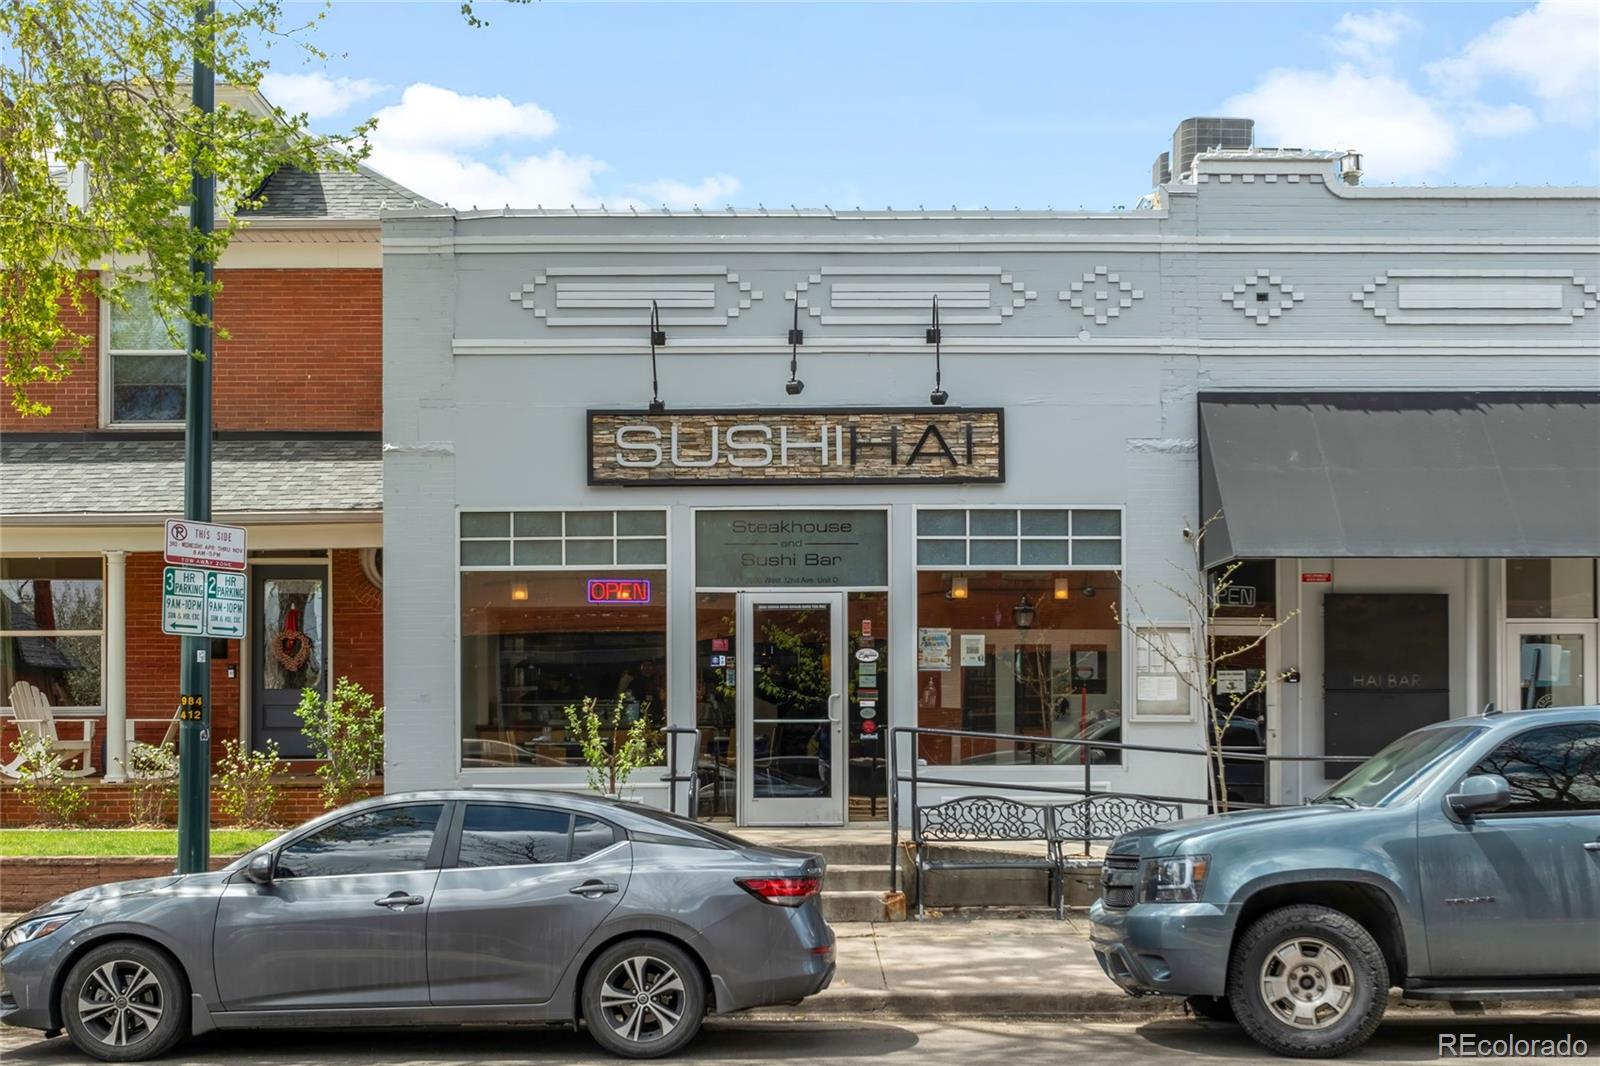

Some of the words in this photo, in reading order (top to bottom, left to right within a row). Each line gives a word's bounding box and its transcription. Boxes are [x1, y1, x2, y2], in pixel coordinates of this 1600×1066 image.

[732, 520, 852, 534] Steakhouse
[195, 529, 210, 540] THIS
[217, 532, 232, 542] SIDE
[780, 540, 803, 548] and
[740, 553, 796, 567] Sushi
[804, 553, 842, 567] Bar
[166, 572, 174, 591] 3
[183, 572, 196, 583] HR
[225, 576, 237, 587] HR
[174, 582, 203, 595] PARKING
[208, 576, 216, 594] 2
[591, 582, 647, 600] OPEN
[217, 586, 244, 598] PARKING
[1215, 588, 1253, 605] PEN
[166, 598, 202, 610] 9AM-10PM
[208, 601, 243, 613] 9AM-10PM
[1353, 674, 1382, 688] HAI
[1387, 673, 1422, 688] BAR
[181, 696, 202, 706] 984
[180, 710, 201, 720] 412
